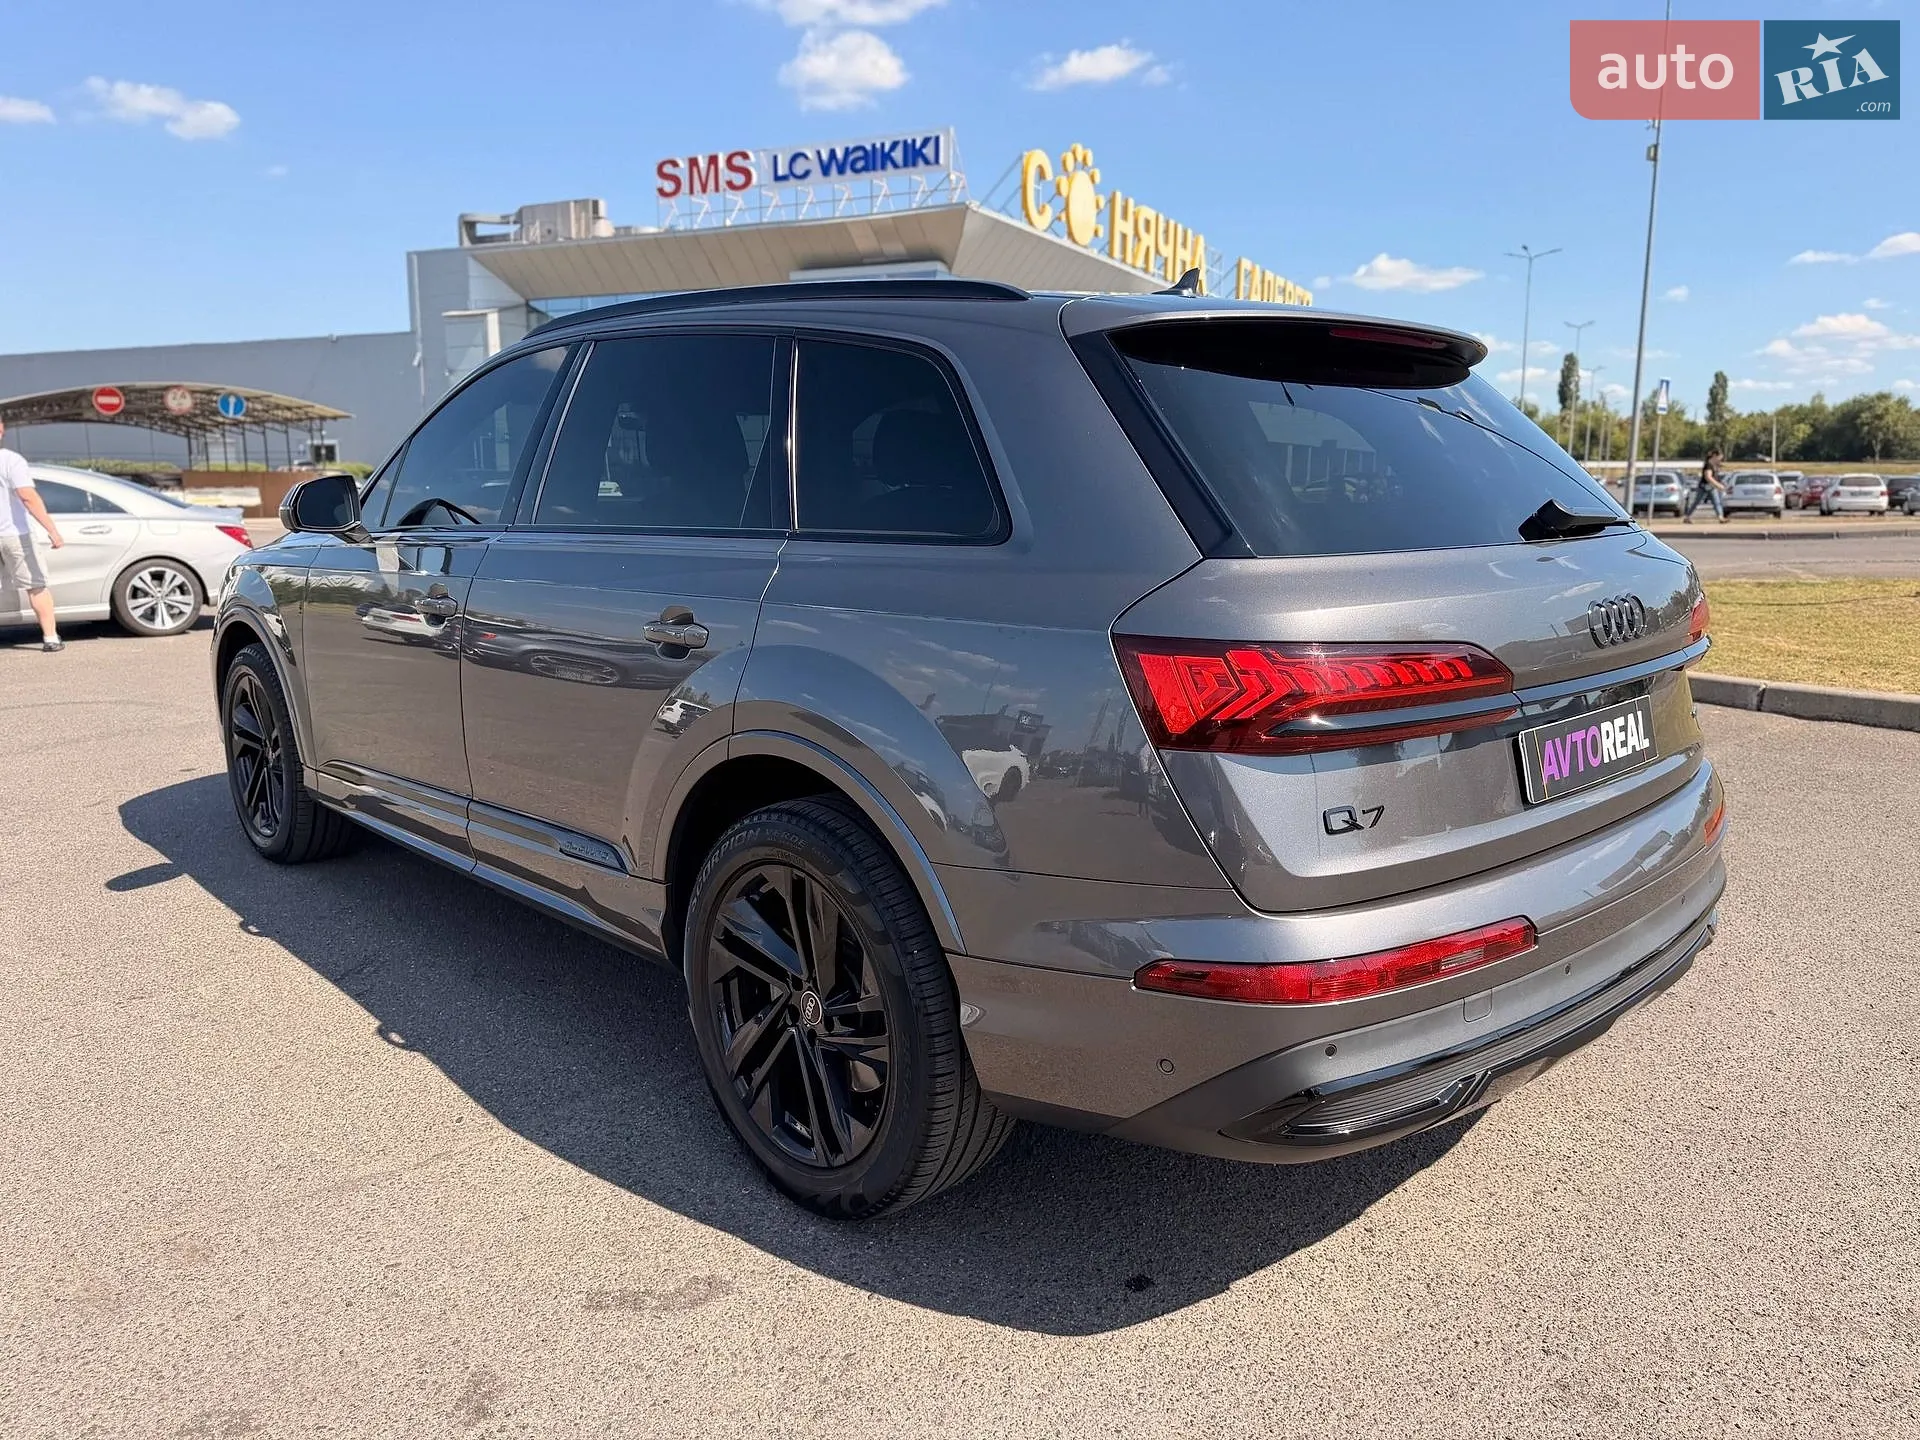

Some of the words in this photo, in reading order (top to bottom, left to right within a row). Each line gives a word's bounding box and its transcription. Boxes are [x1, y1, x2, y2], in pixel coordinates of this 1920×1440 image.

[656, 150, 753, 199] SMS
[772, 151, 812, 182] LC
[1541, 710, 1650, 785] AVTOREAL
[1322, 805, 1385, 836] Q7
